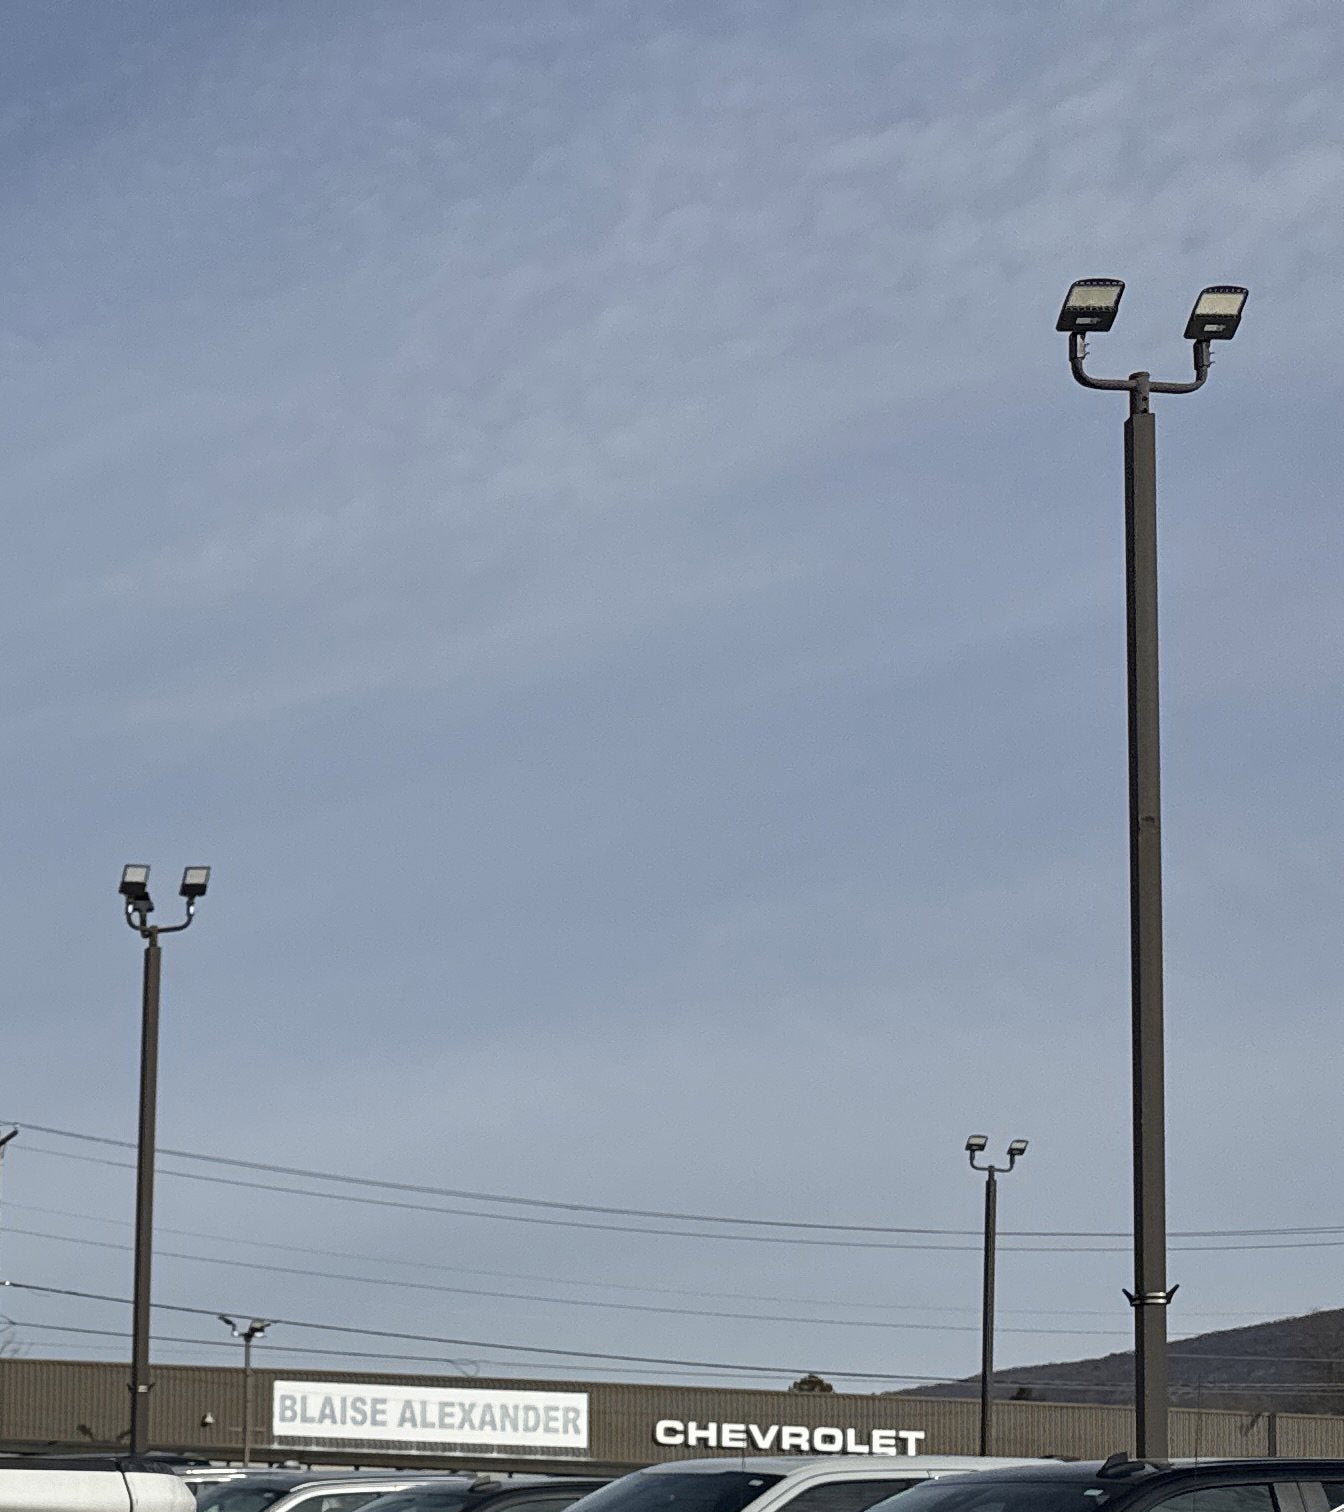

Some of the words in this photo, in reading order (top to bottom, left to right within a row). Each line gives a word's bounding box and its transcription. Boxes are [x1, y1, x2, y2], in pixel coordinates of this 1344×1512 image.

[278, 1394, 387, 1427] BLAISE
[397, 1399, 581, 1435] ALEXANDER
[655, 1420, 925, 1456] CHEVROLET
